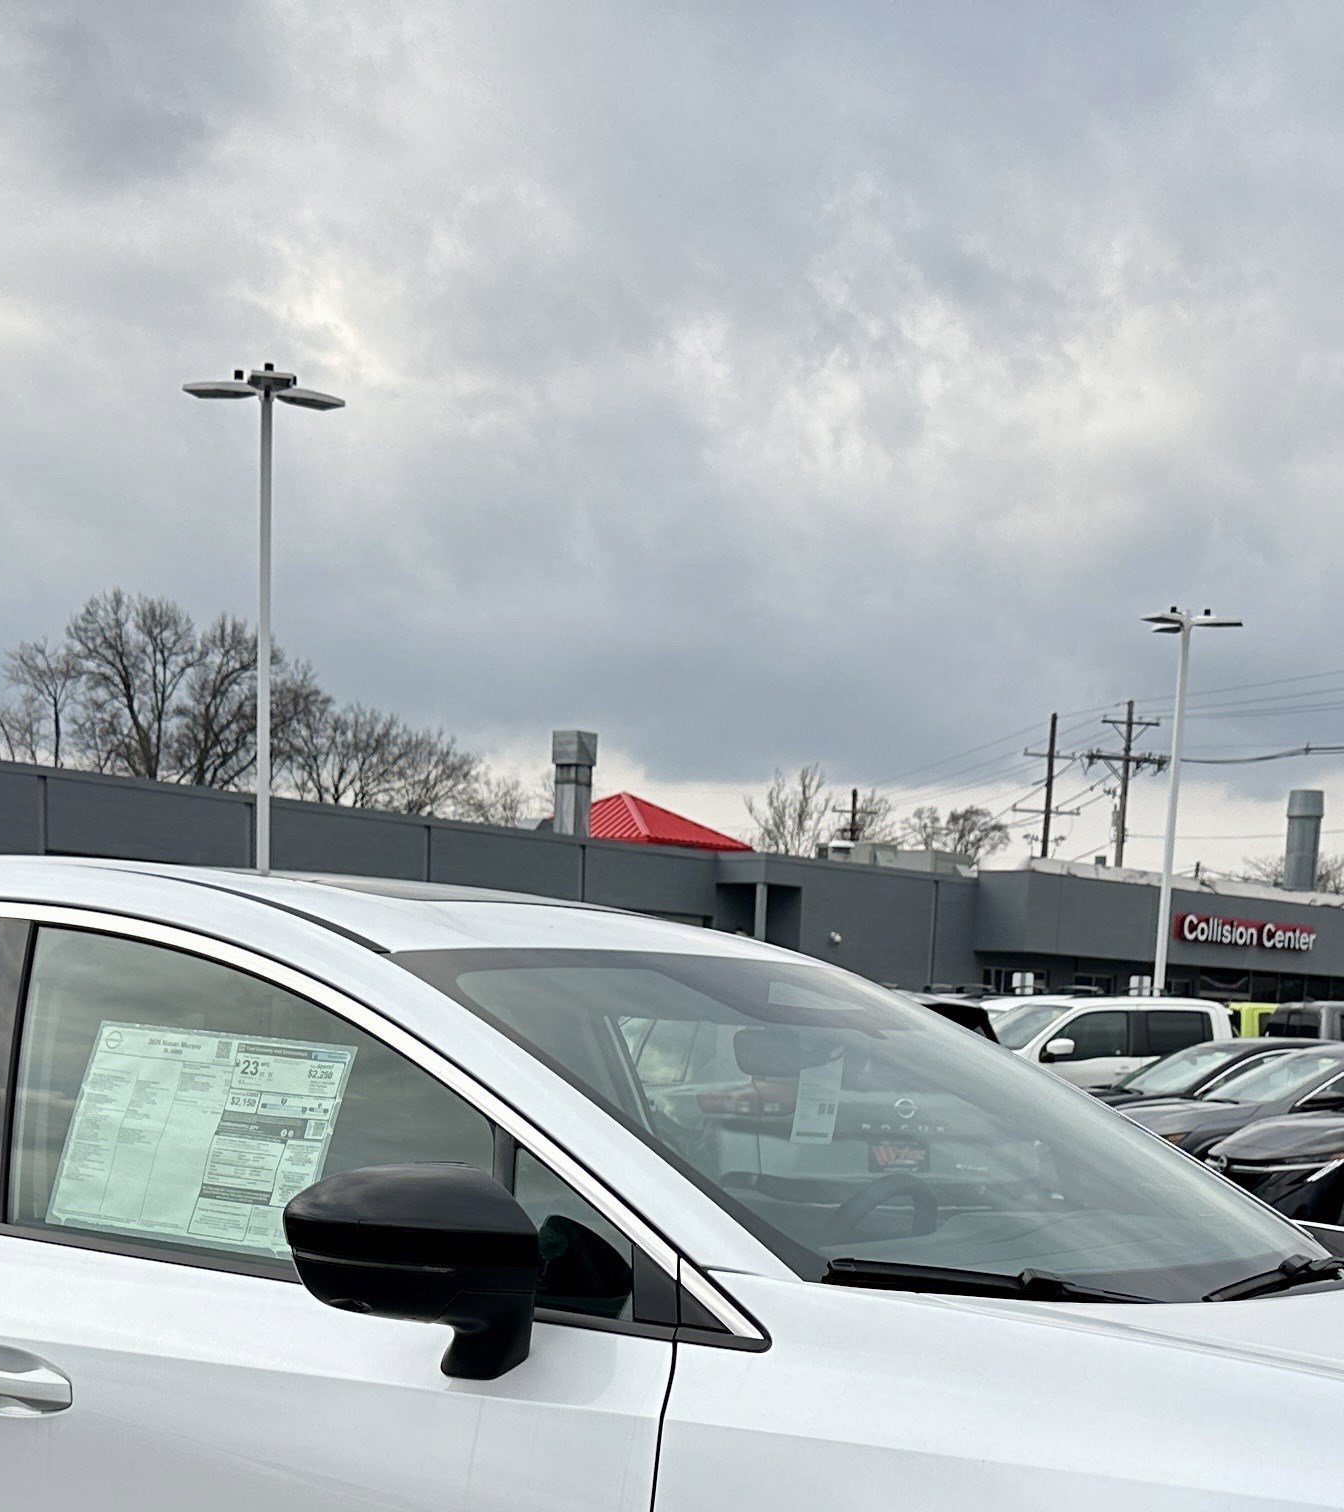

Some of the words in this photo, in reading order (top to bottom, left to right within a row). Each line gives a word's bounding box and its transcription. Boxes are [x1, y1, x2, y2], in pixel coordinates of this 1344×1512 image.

[1183, 914, 1257, 946] Collision
[1262, 922, 1317, 951] Center
[240, 1060, 260, 1076] 23
